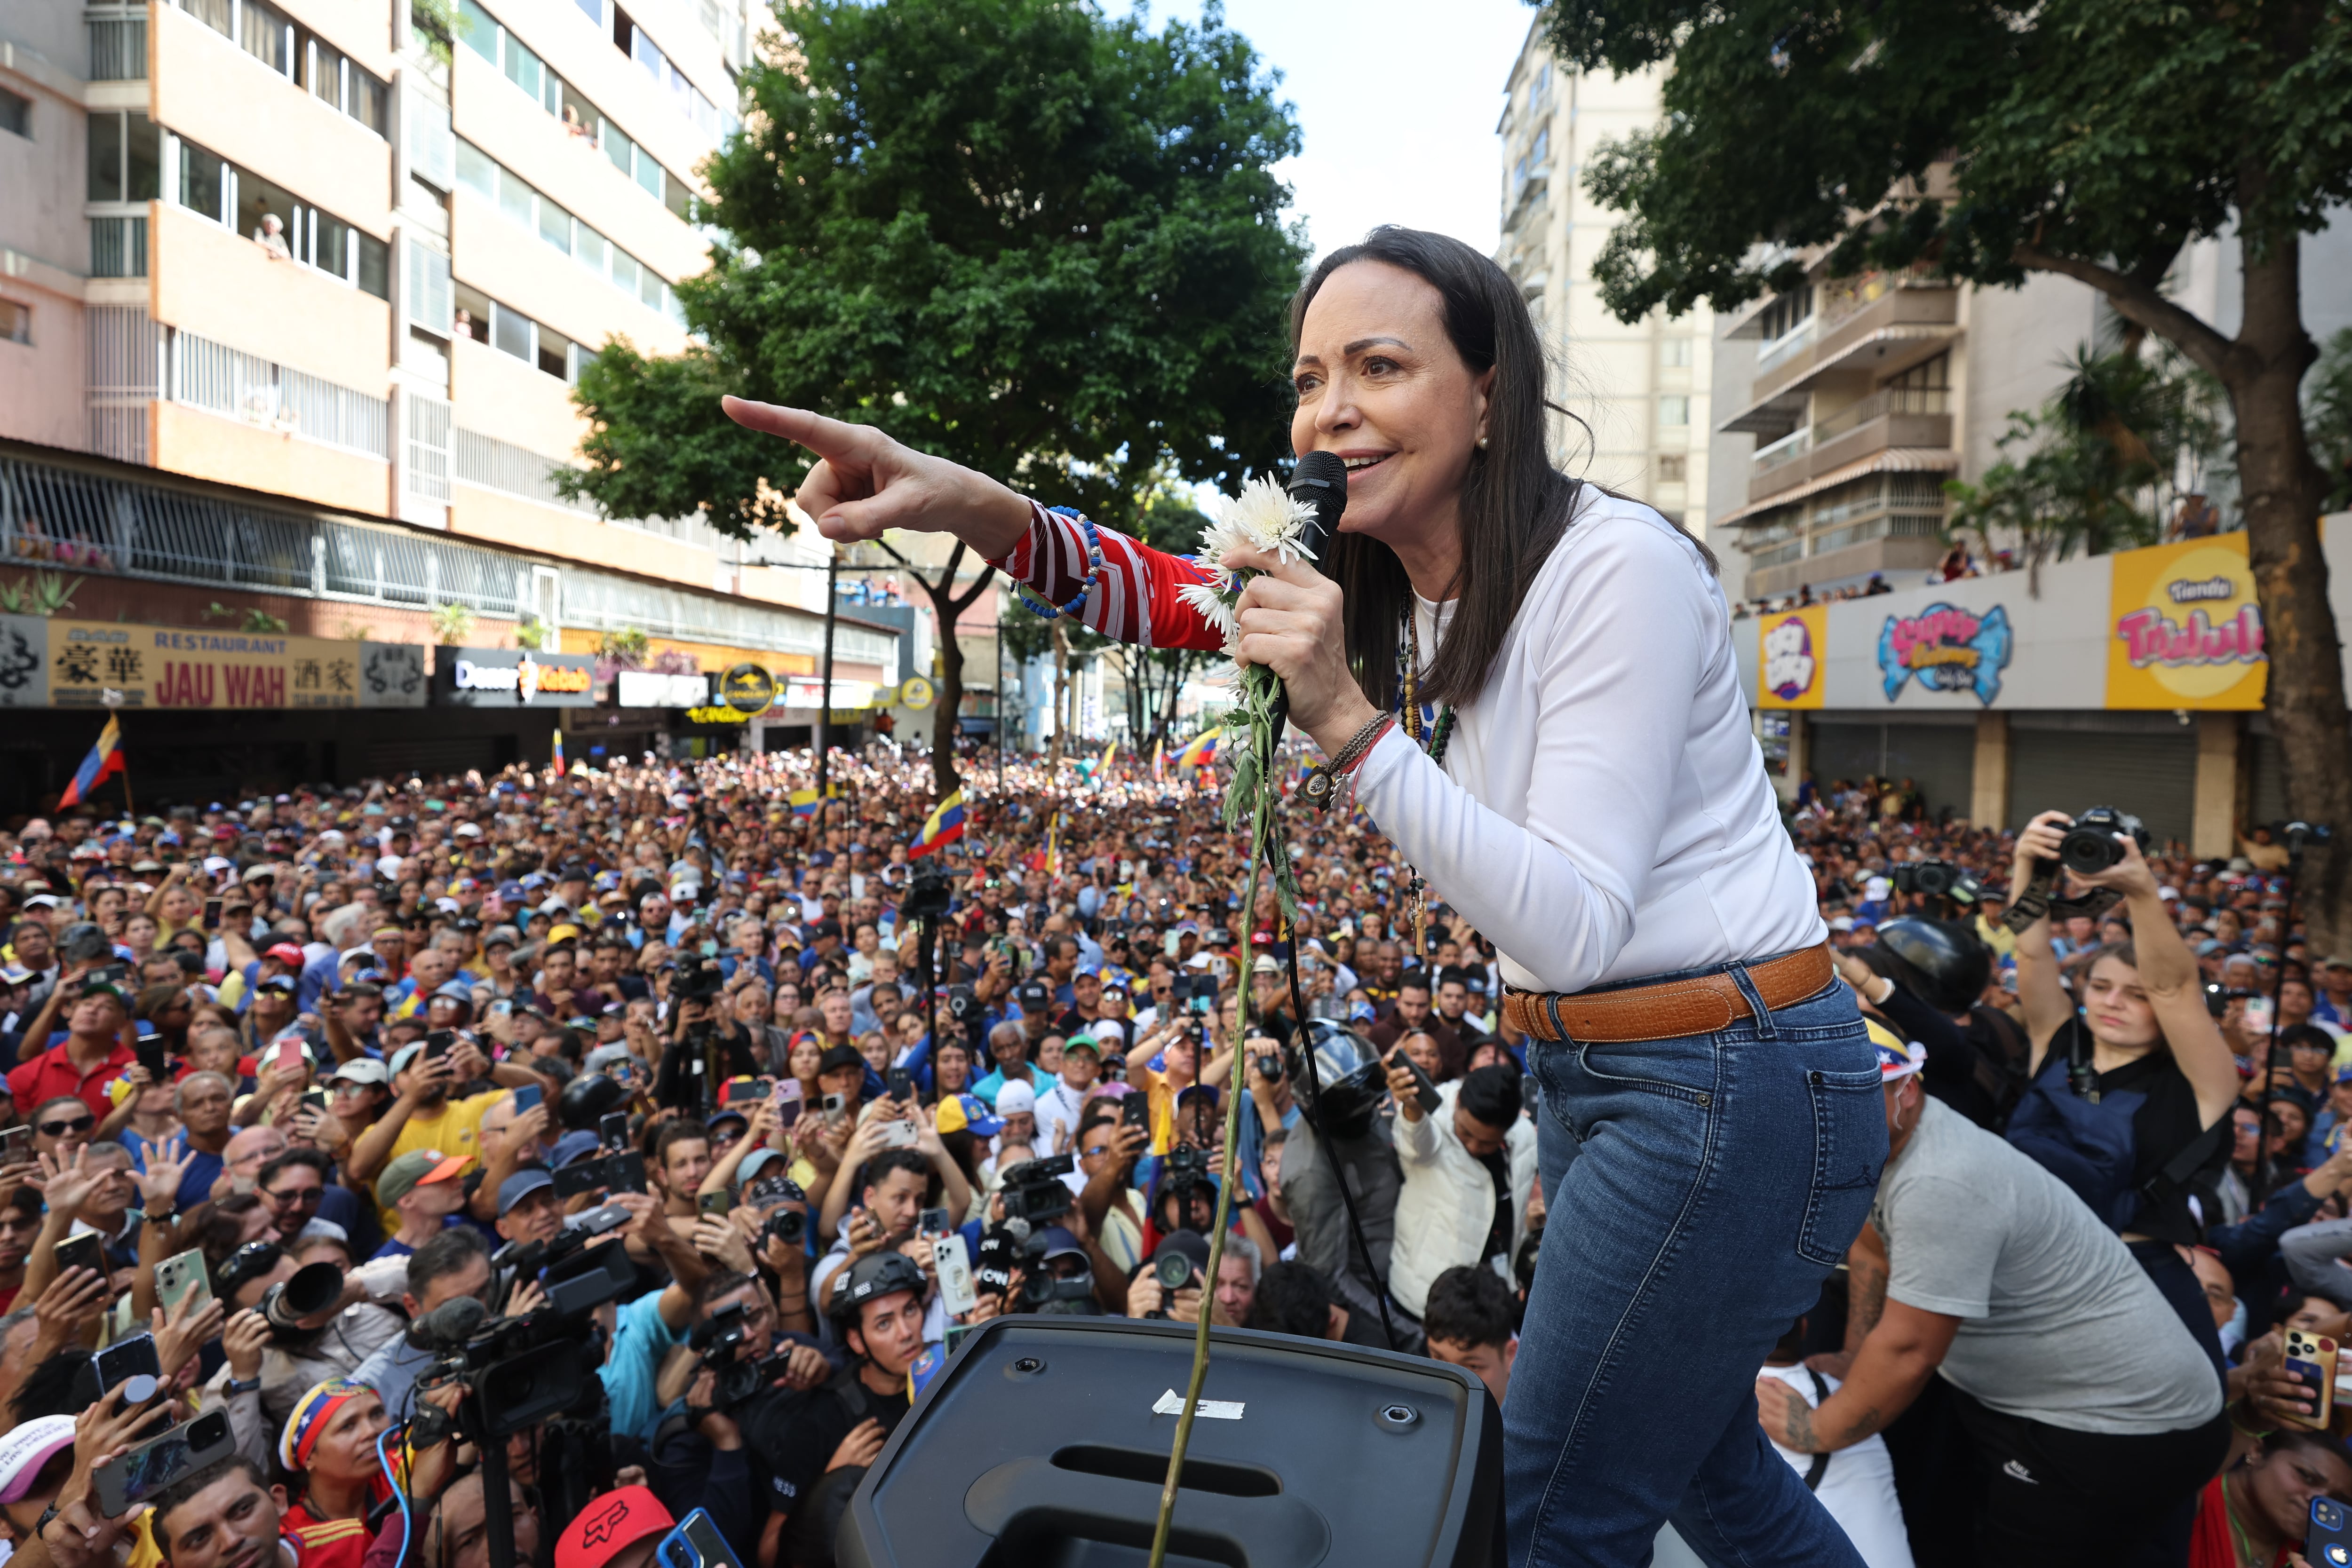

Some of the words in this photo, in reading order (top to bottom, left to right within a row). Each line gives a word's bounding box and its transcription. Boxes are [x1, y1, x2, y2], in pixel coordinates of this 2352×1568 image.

[2168, 577, 2231, 602] Tienda
[67, 628, 129, 643] BAR
[155, 632, 286, 653] RESTAURANT
[2118, 606, 2265, 665] Trulul
[57, 643, 143, 683] 豪華
[294, 658, 353, 690] 酒家
[156, 662, 213, 705] JAU
[223, 664, 285, 707] WAH
[537, 665, 592, 691] Kebab
[2010, 1459, 2031, 1476] NIKE
